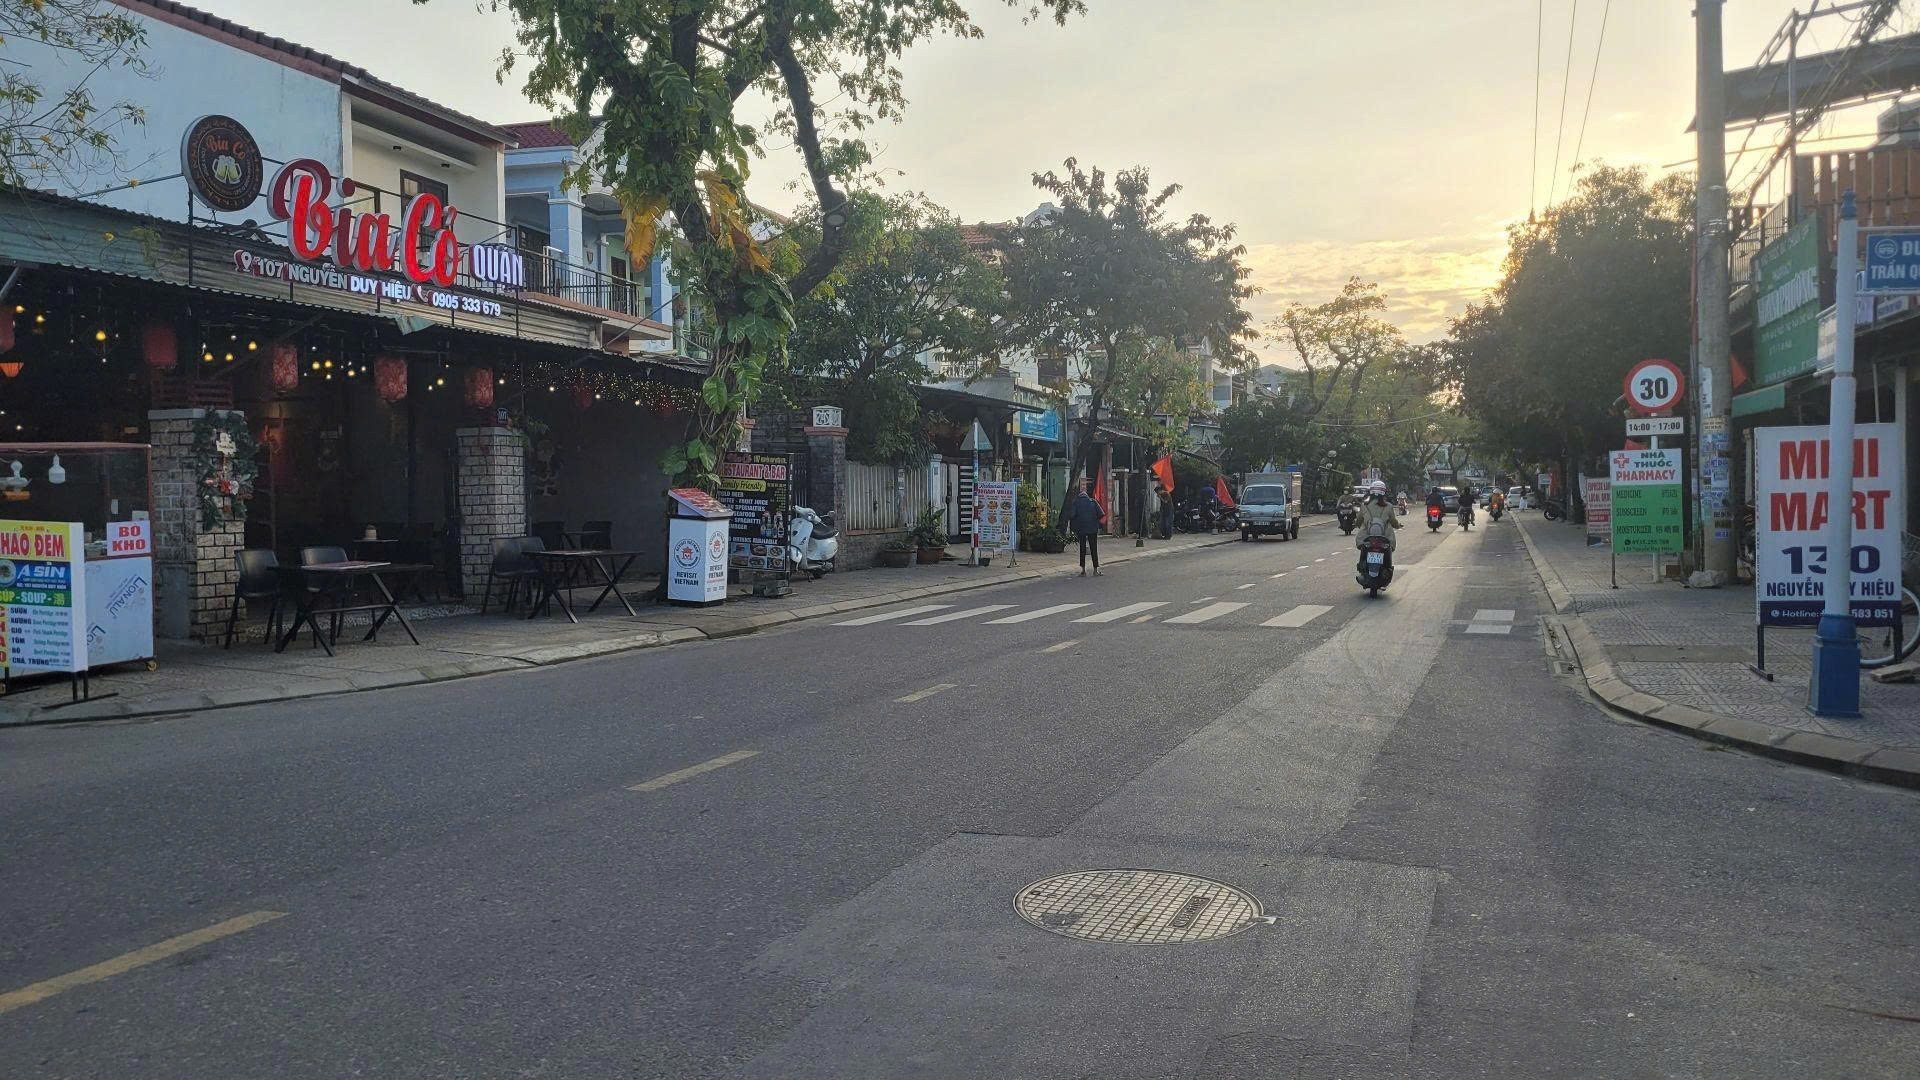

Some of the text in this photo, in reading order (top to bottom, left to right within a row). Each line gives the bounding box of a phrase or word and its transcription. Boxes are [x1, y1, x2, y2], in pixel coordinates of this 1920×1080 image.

[268, 158, 398, 271] Bia
[473, 244, 523, 287] QUÁN
[258, 258, 284, 278] 107
[350, 276, 378, 295] DUY
[381, 278, 412, 302] HIỆU
[432, 292, 501, 317] 0905 333 679
[1641, 377, 1668, 400] 30
[1628, 423, 1651, 431] 14:00
[1658, 421, 1681, 430] 17:00
[771, 465, 787, 481] BAR
[1616, 469, 1675, 481] PHARMACY
[1616, 489, 1642, 498] MEDICINE
[112, 538, 146, 552] KHO
[674, 578, 699, 586] VIETNAM
[676, 571, 698, 579] REVISIT
[1766, 577, 1824, 597] NGUYỄN
[1861, 578, 1895, 600] HIỆU
[21, 591, 47, 604] SOUP
[1782, 609, 1819, 618] Hotline:
